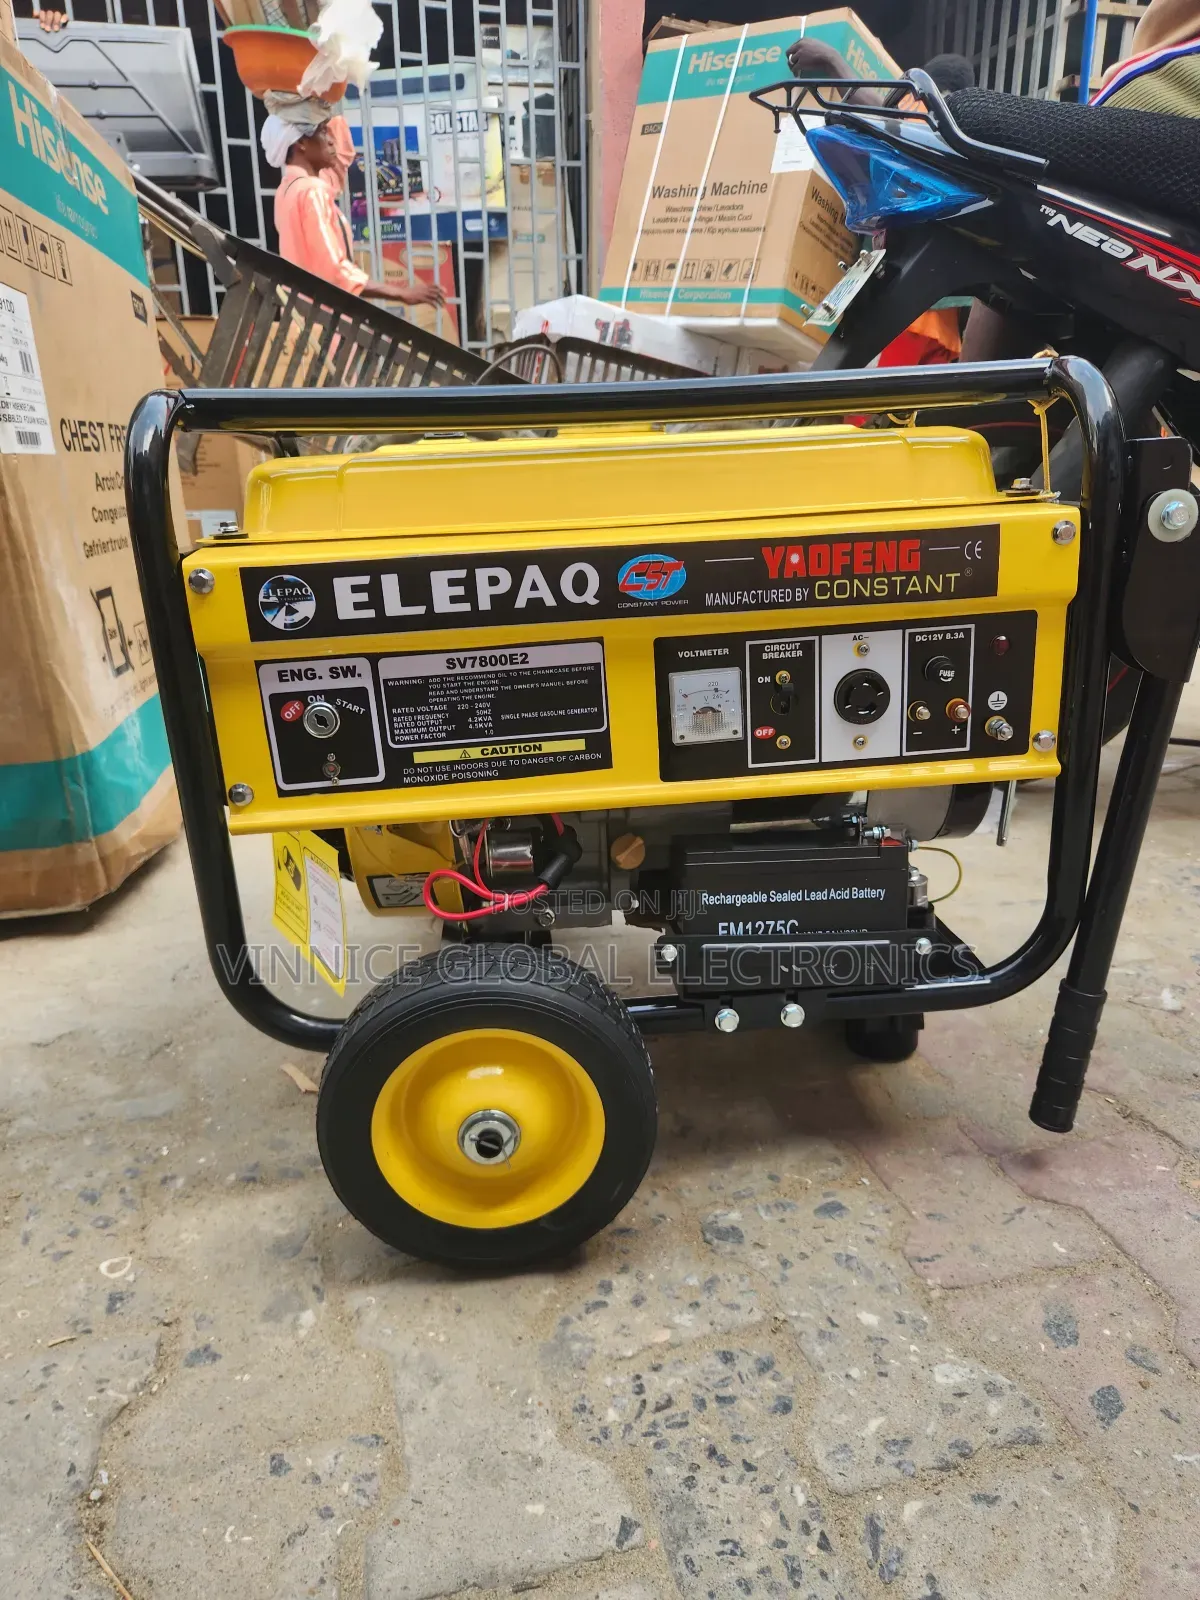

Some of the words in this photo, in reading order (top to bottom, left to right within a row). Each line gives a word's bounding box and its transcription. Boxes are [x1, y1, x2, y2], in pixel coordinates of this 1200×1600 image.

[687, 45, 782, 75] Hisense
[8, 79, 109, 216] Hisense
[651, 184, 707, 200] Washing
[711, 180, 768, 196] Machine
[665, 204, 712, 213] Waschmahine
[1039, 204, 1057, 217] TVS
[682, 215, 713, 224] La-linge
[1046, 213, 1134, 259] NEO
[677, 289, 731, 300] Corporation
[60, 417, 106, 453] CHEST
[762, 539, 921, 579] YAOFENG
[964, 540, 983, 560] CE
[618, 560, 685, 593] CST
[262, 587, 312, 597] ELEPAQ
[332, 561, 601, 621] ELEPAQ
[705, 588, 792, 607] MANUFACTURED
[795, 587, 810, 602] BY
[814, 572, 961, 600] CONSTANT
[617, 601, 659, 609] CONSTANT
[915, 633, 944, 642] DC12V
[945, 631, 965, 640] 8.3A
[678, 648, 730, 659] VOLTMETER
[764, 643, 801, 652] CIRCUIT
[445, 652, 530, 670] SV7800E2
[762, 650, 803, 660] BREAKER
[277, 668, 323, 683] ENG.
[328, 665, 362, 679] SW.
[387, 678, 425, 687] WARNING:
[456, 673, 496, 682] RECOMMEND
[939, 669, 955, 678] FUSE
[459, 686, 499, 695] UNDERSTAND
[307, 694, 325, 703] ON
[284, 702, 302, 719] OFF
[335, 698, 366, 715] START
[416, 705, 448, 713] VOLTAGE
[414, 713, 449, 721] FREQUENCY
[501, 713, 520, 721] SINGLE
[539, 709, 565, 717] GASOLINE
[566, 707, 598, 715] GENERATOR
[394, 721, 415, 729] RATED
[394, 728, 427, 736] MAXIMUM
[428, 725, 456, 733] OUTPUT
[395, 734, 419, 742] POWER
[421, 732, 446, 740] FACTOR
[756, 728, 774, 737] OFF
[480, 744, 543, 757] CAUTION
[417, 766, 433, 774] NOT
[453, 762, 489, 771] INDOORS
[491, 760, 508, 768] DUE
[522, 756, 555, 765] DANGER
[568, 753, 602, 761] CARBON
[403, 774, 449, 784] MONOXIDE
[451, 770, 499, 780] POISONING
[702, 891, 768, 907] Rechargeable
[769, 889, 802, 903] Sealed
[804, 888, 828, 902] Lead
[829, 888, 850, 900] Acid
[851, 887, 886, 901] Battery
